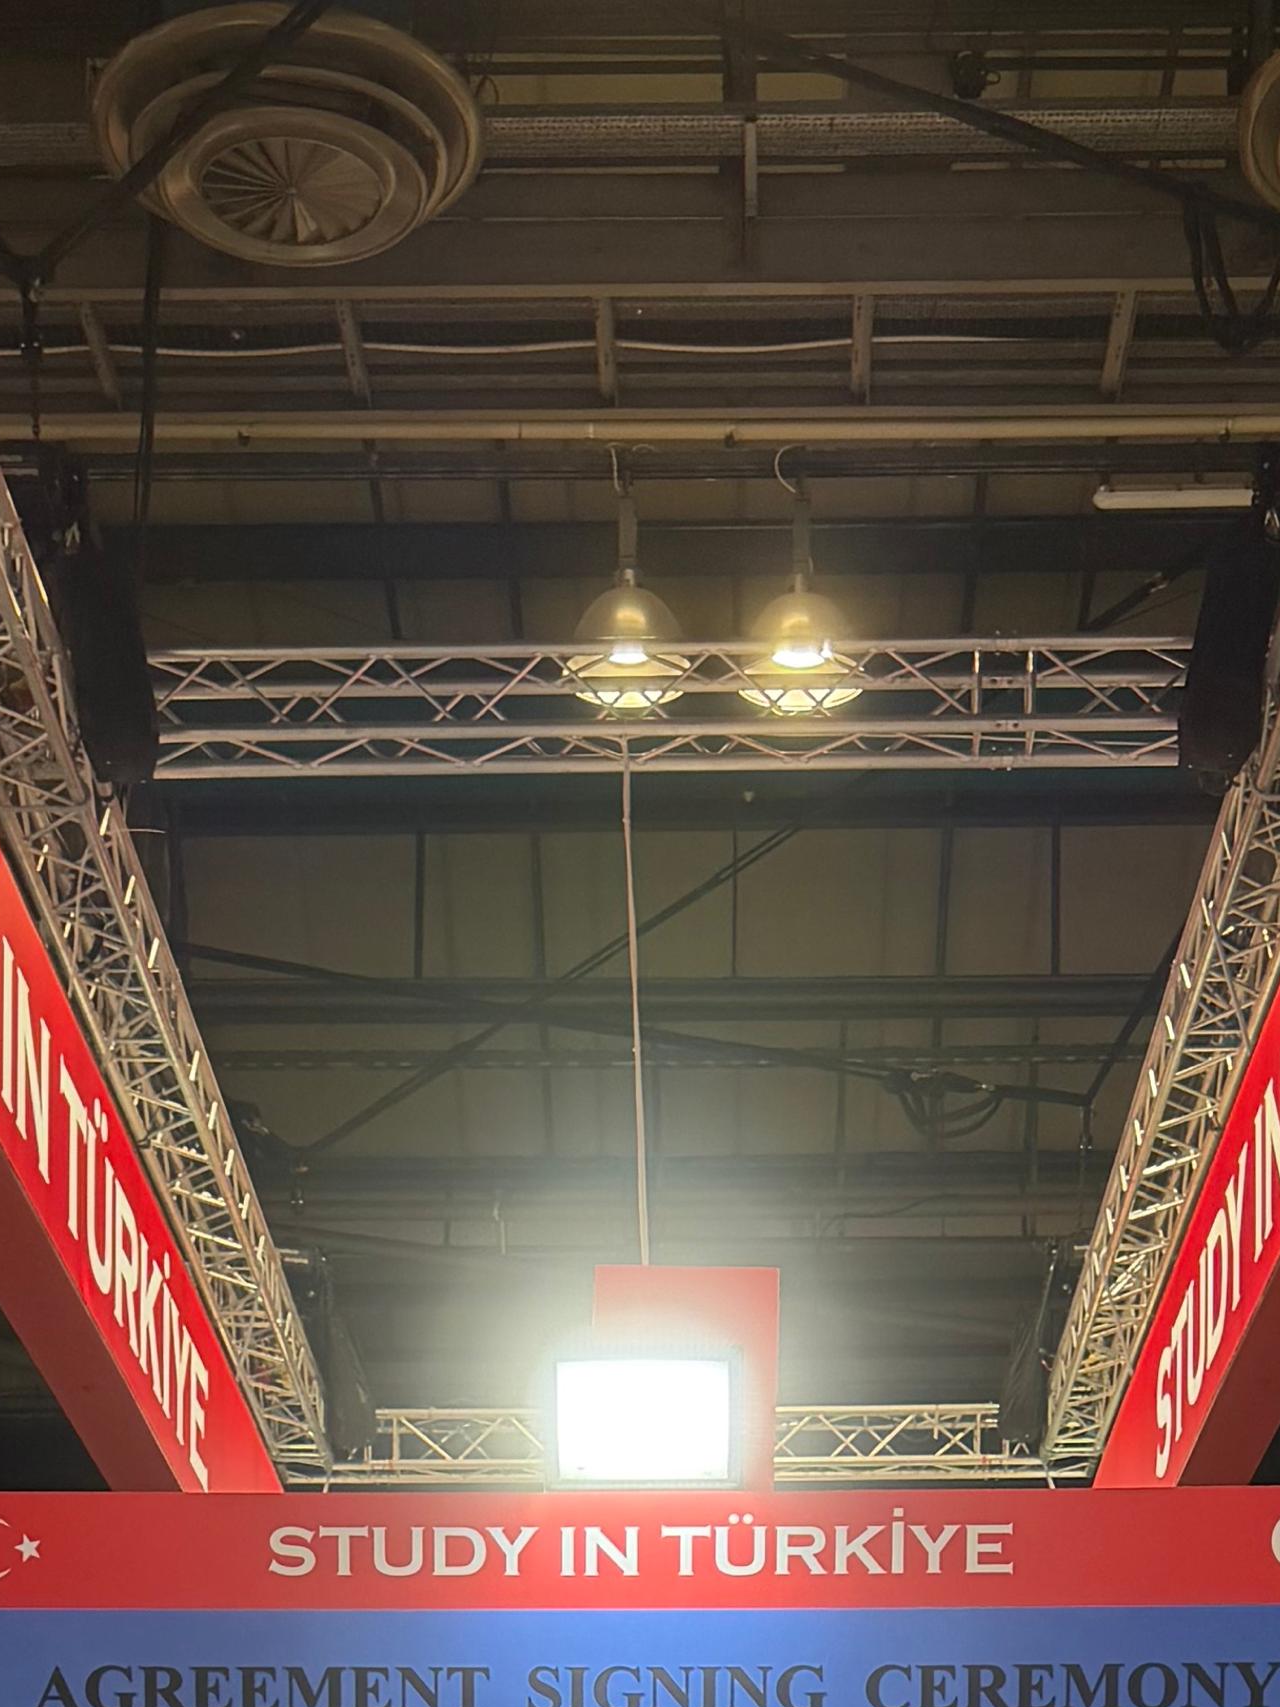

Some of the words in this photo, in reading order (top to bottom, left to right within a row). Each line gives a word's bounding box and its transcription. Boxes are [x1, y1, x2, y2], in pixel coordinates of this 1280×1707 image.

[1, 935, 53, 1185] IN
[59, 1064, 210, 1494] TÜRKİYE
[1154, 1139, 1249, 1480] STUDY
[268, 1524, 524, 1577] STUDY
[559, 1525, 640, 1577] IN
[660, 1507, 1014, 1577] TÜRKİYE
